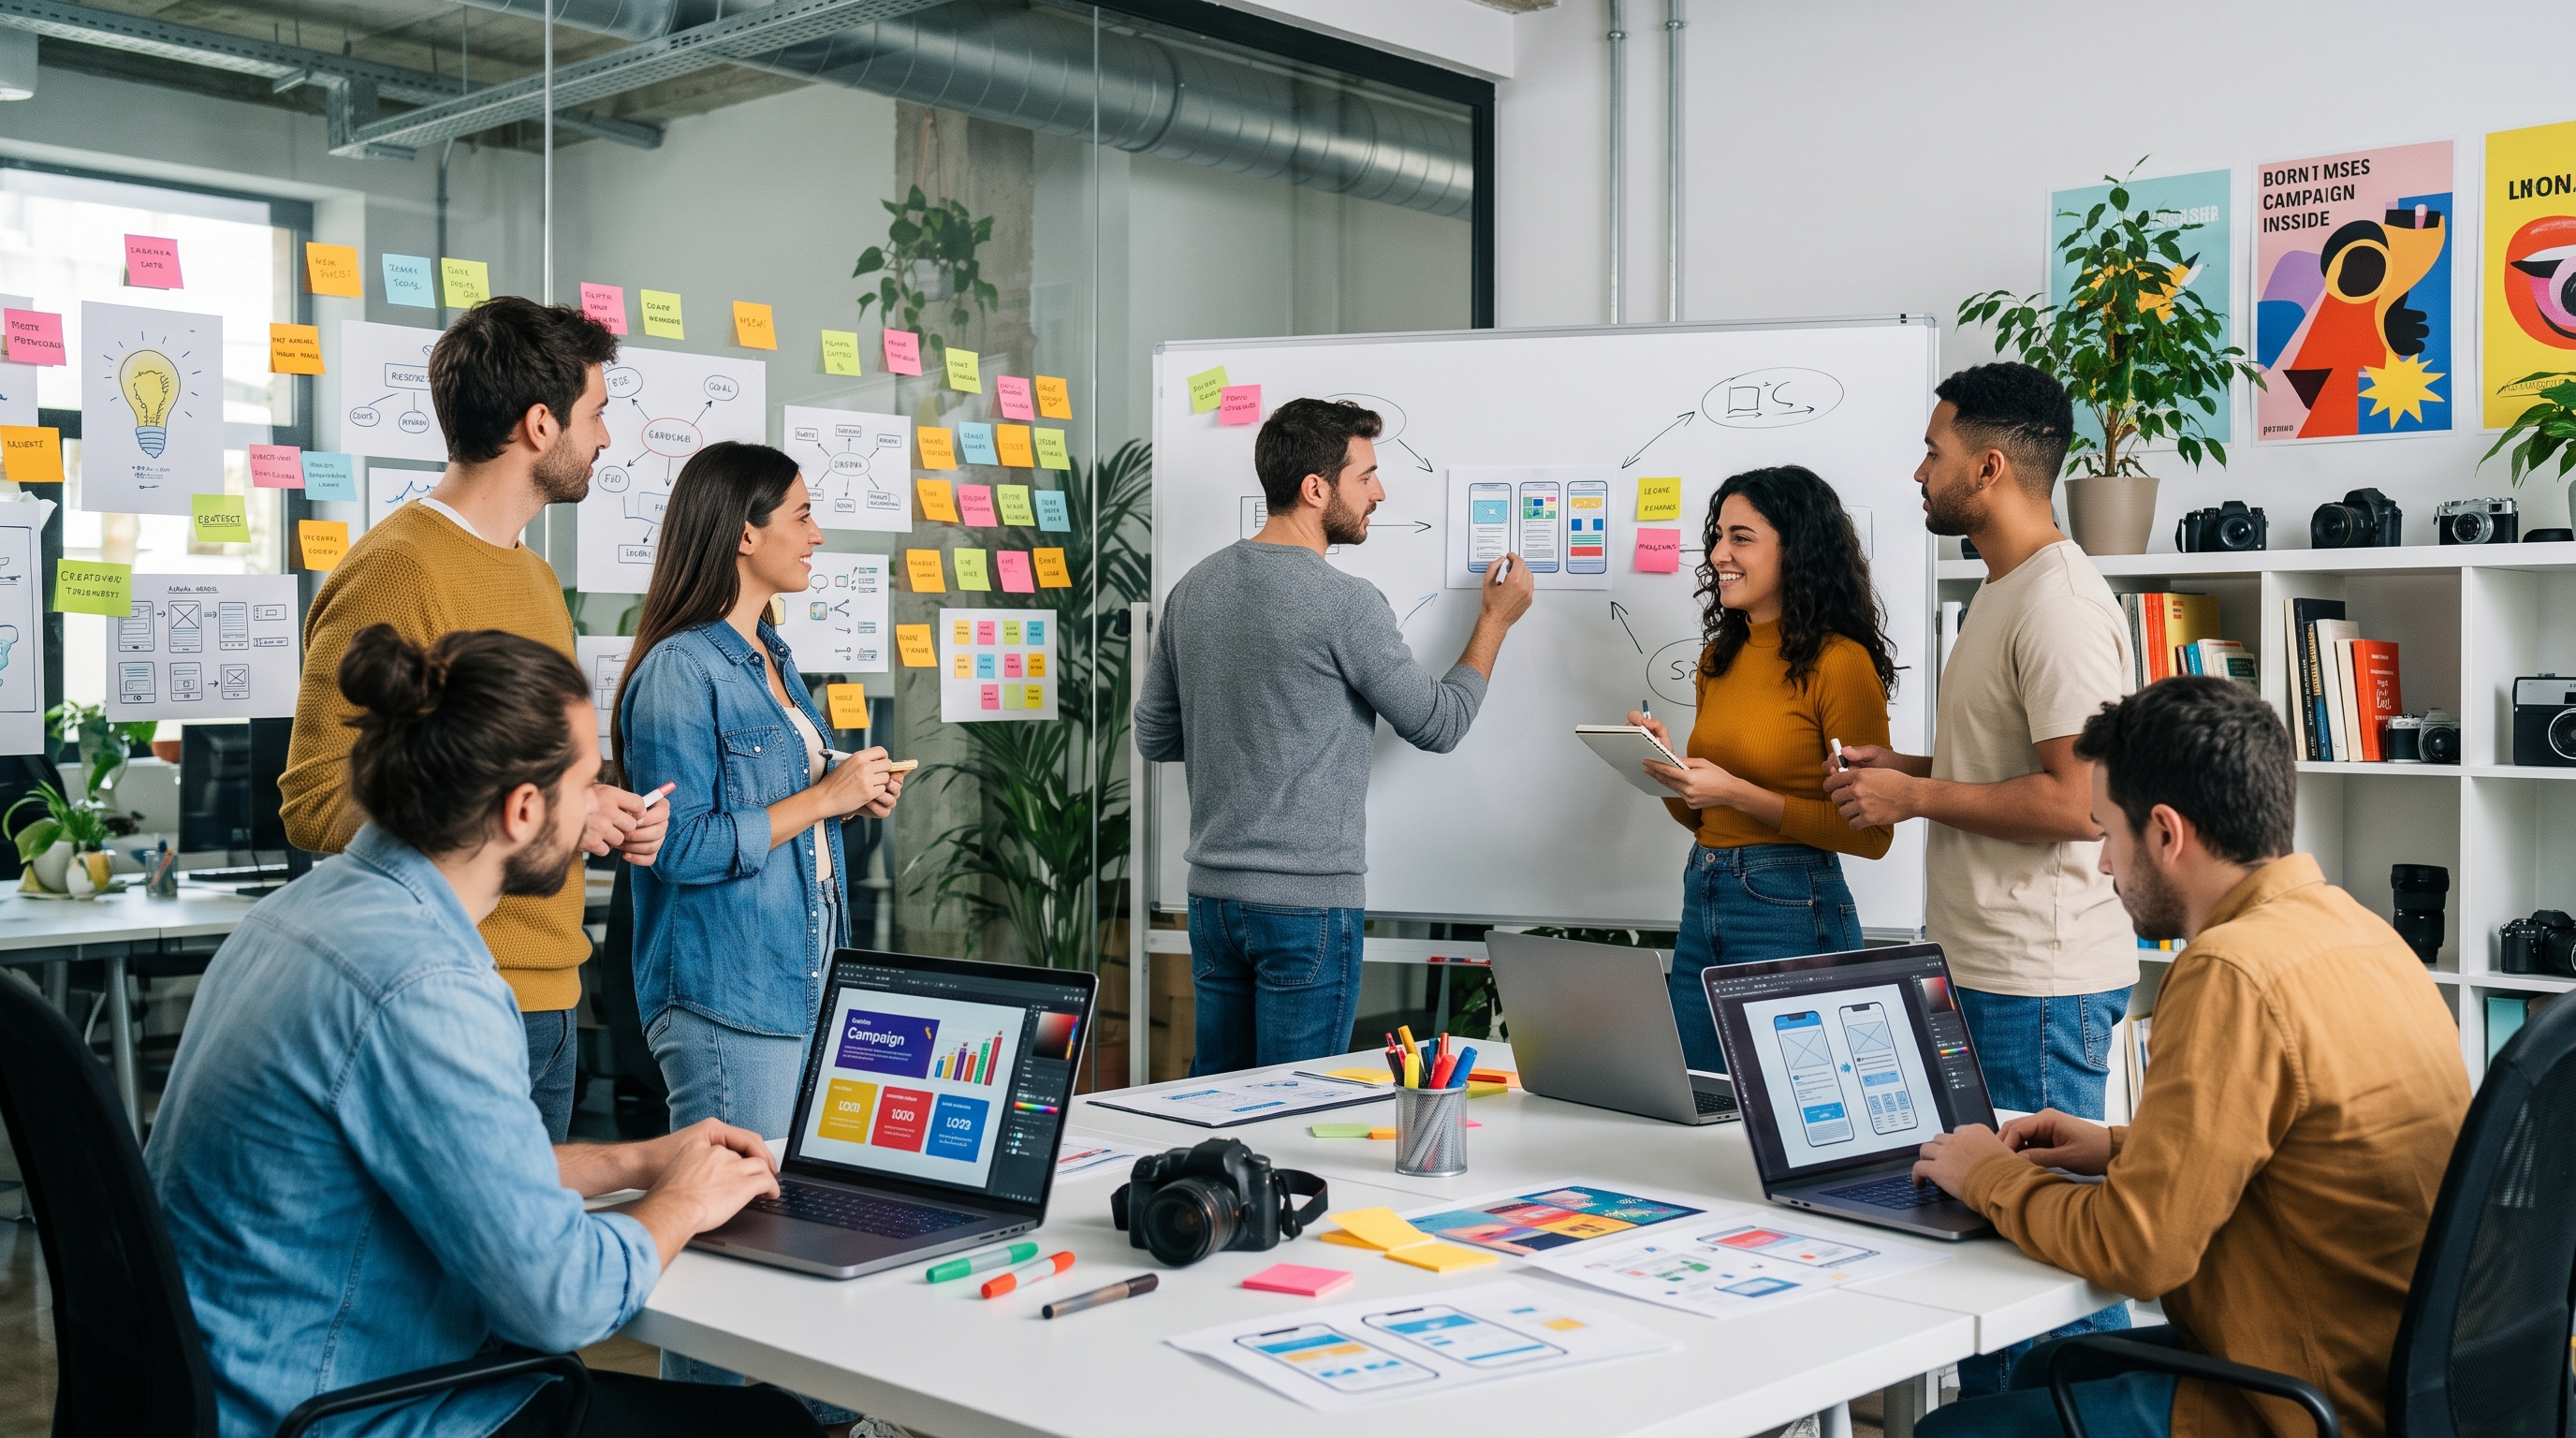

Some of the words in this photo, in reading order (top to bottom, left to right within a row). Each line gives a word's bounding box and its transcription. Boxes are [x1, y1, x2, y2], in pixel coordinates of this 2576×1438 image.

[2263, 184, 2355, 210] CAMPAIGN
[2263, 211, 2330, 233] INSSIDE
[847, 1027, 904, 1048] Campaign
